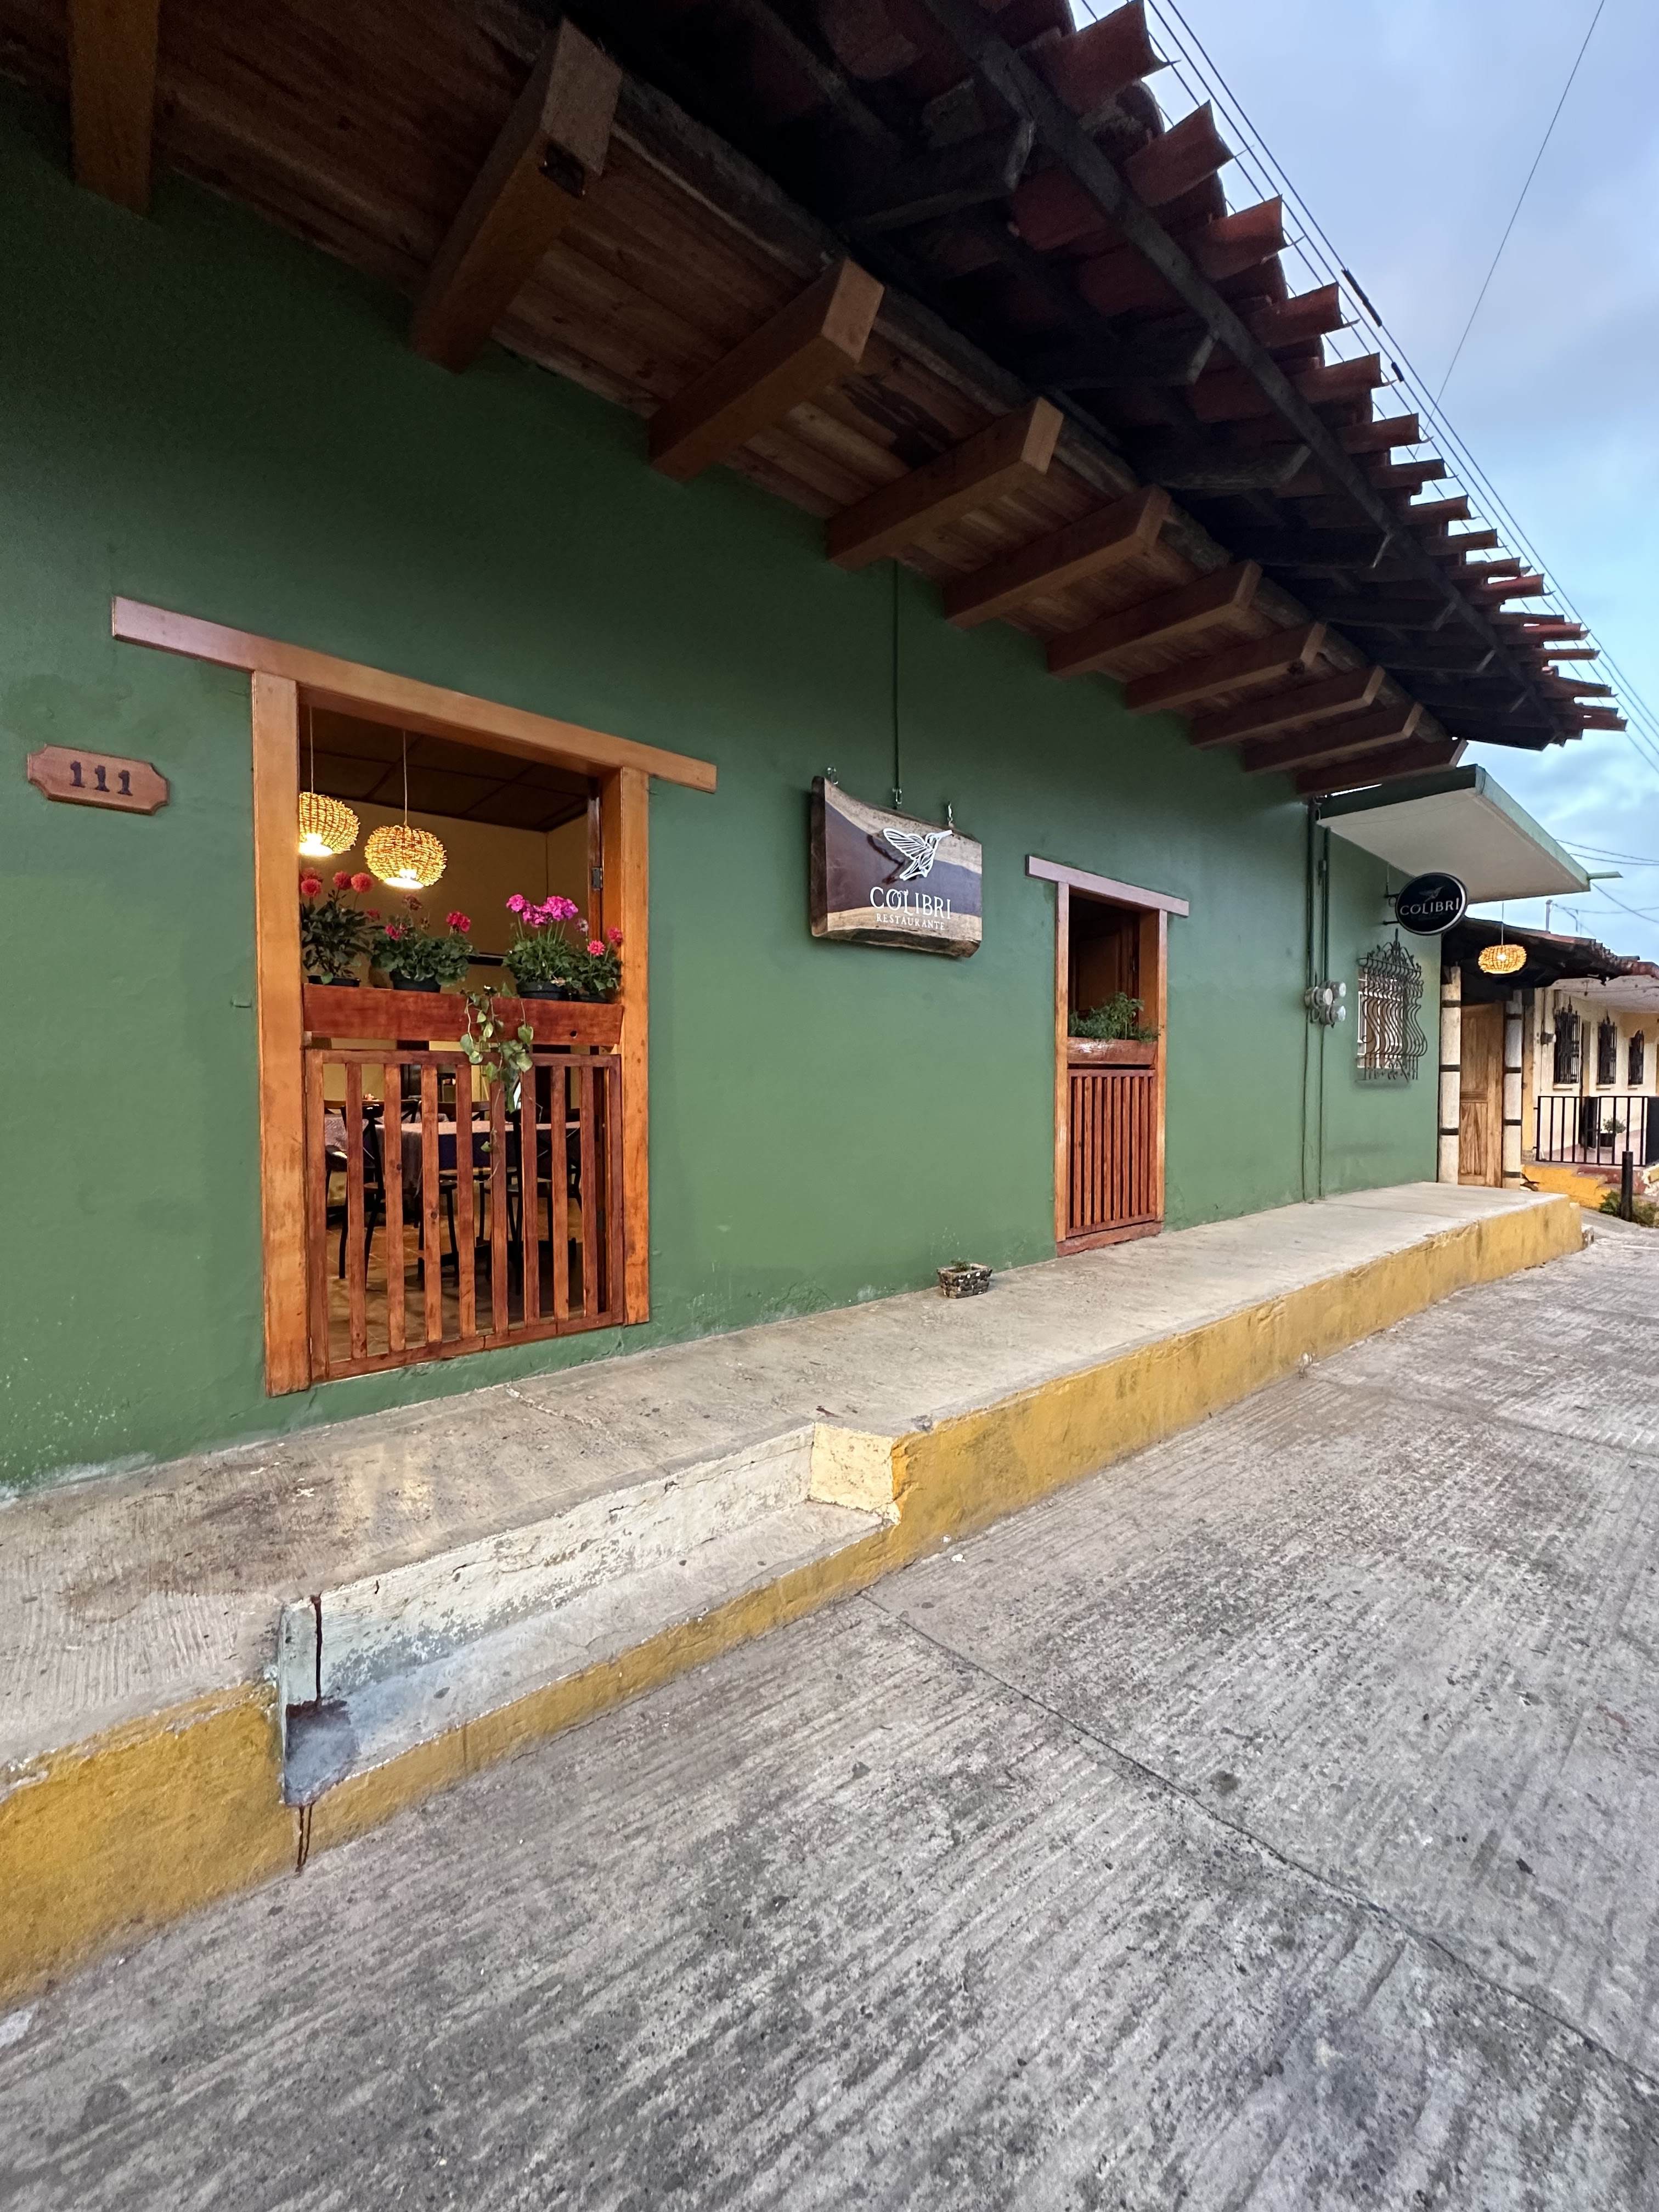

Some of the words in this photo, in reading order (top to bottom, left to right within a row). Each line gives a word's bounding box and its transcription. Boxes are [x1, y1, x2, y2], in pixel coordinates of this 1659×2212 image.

[70, 760, 133, 795] 111
[870, 887, 951, 919] COLIBRI
[1400, 898, 1459, 915] COLIBRI
[876, 913, 945, 930] RESTAURANTE
